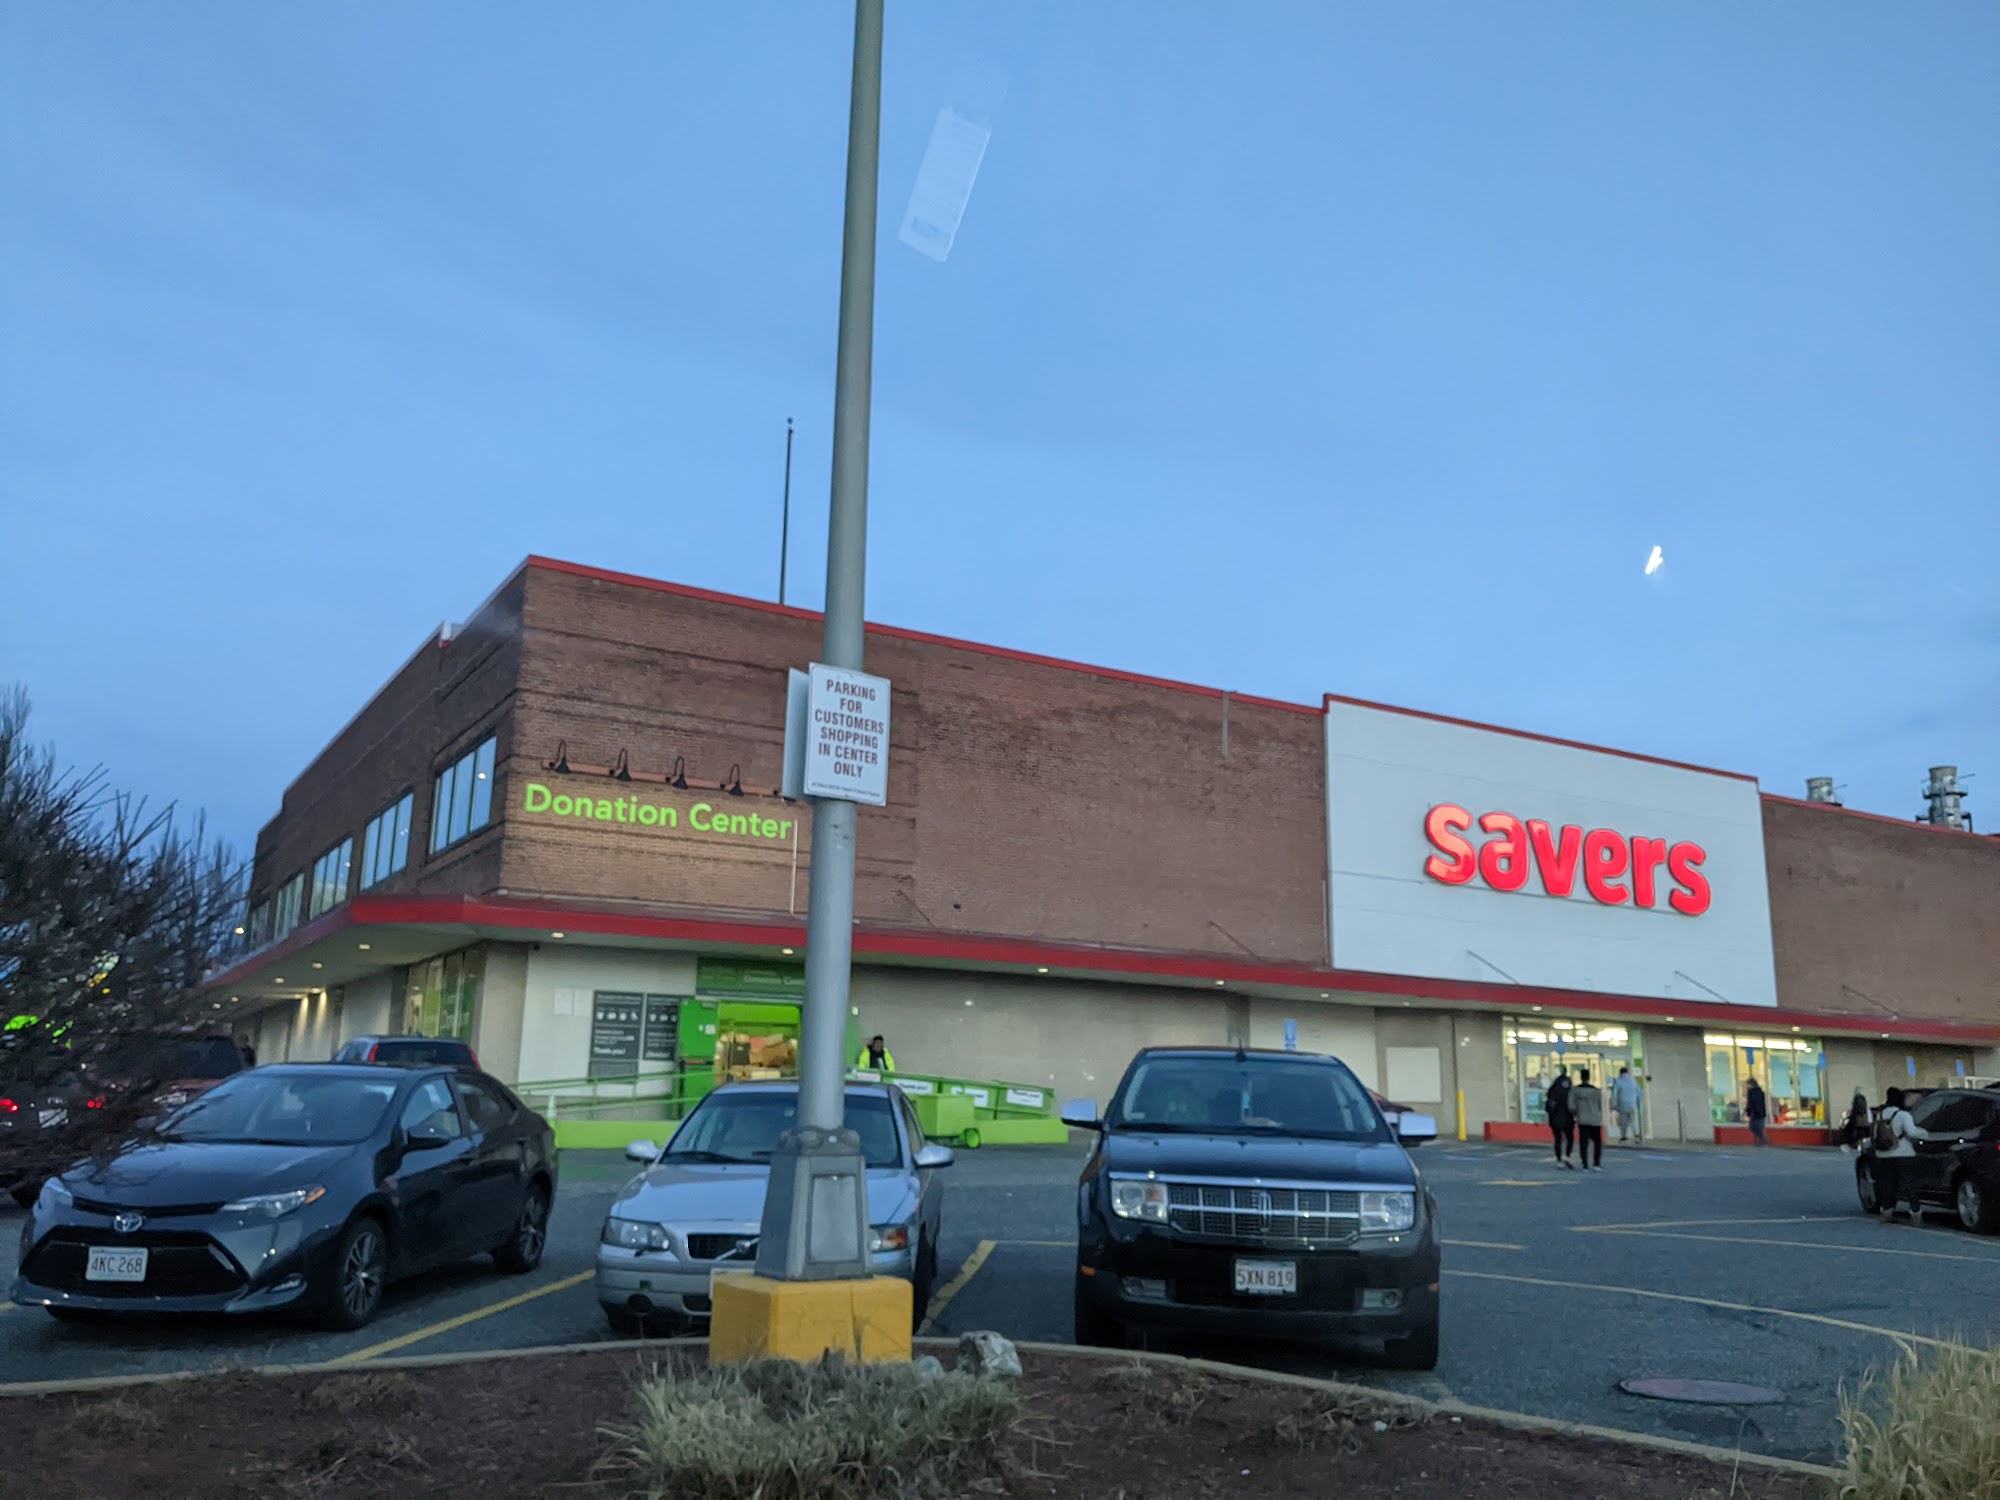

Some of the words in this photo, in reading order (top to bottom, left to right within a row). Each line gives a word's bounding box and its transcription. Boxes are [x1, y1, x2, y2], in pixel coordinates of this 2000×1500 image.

[826, 679, 876, 701] PARKING
[840, 698, 863, 714] FOR
[814, 708, 885, 735] CUSTOMERS
[820, 726, 878, 750] SHOPPING
[818, 742, 831, 757] IN
[835, 745, 878, 766] CENTER
[833, 761, 863, 778] ONLY
[525, 783, 678, 828] Donation
[689, 802, 792, 840] Center
[118, 1256, 143, 1273] 268
[1237, 1268, 1264, 1286] 5XN
[1267, 1270, 1294, 1287] 819
